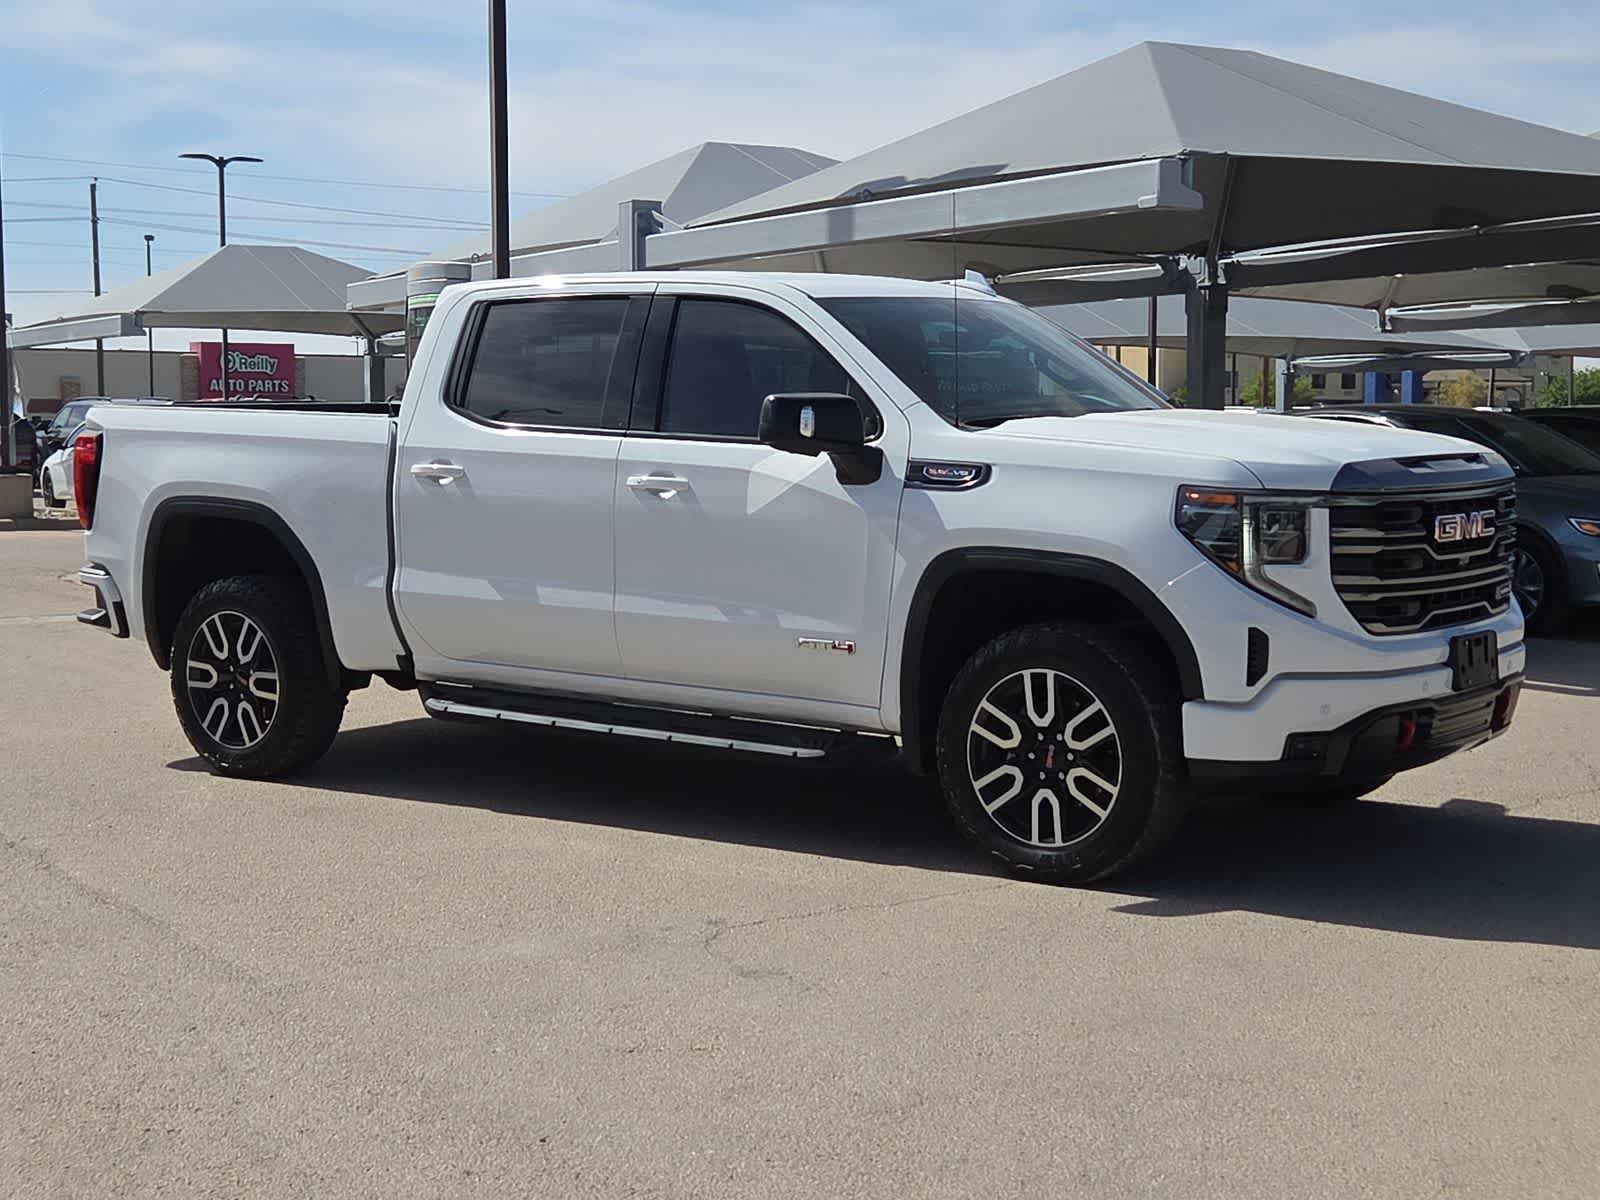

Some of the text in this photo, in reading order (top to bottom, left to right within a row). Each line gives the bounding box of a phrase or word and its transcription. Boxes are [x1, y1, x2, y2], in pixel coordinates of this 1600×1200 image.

[220, 352, 278, 374] O'Reilly
[248, 380, 289, 392] PARTS
[1434, 509, 1496, 542] GMC
